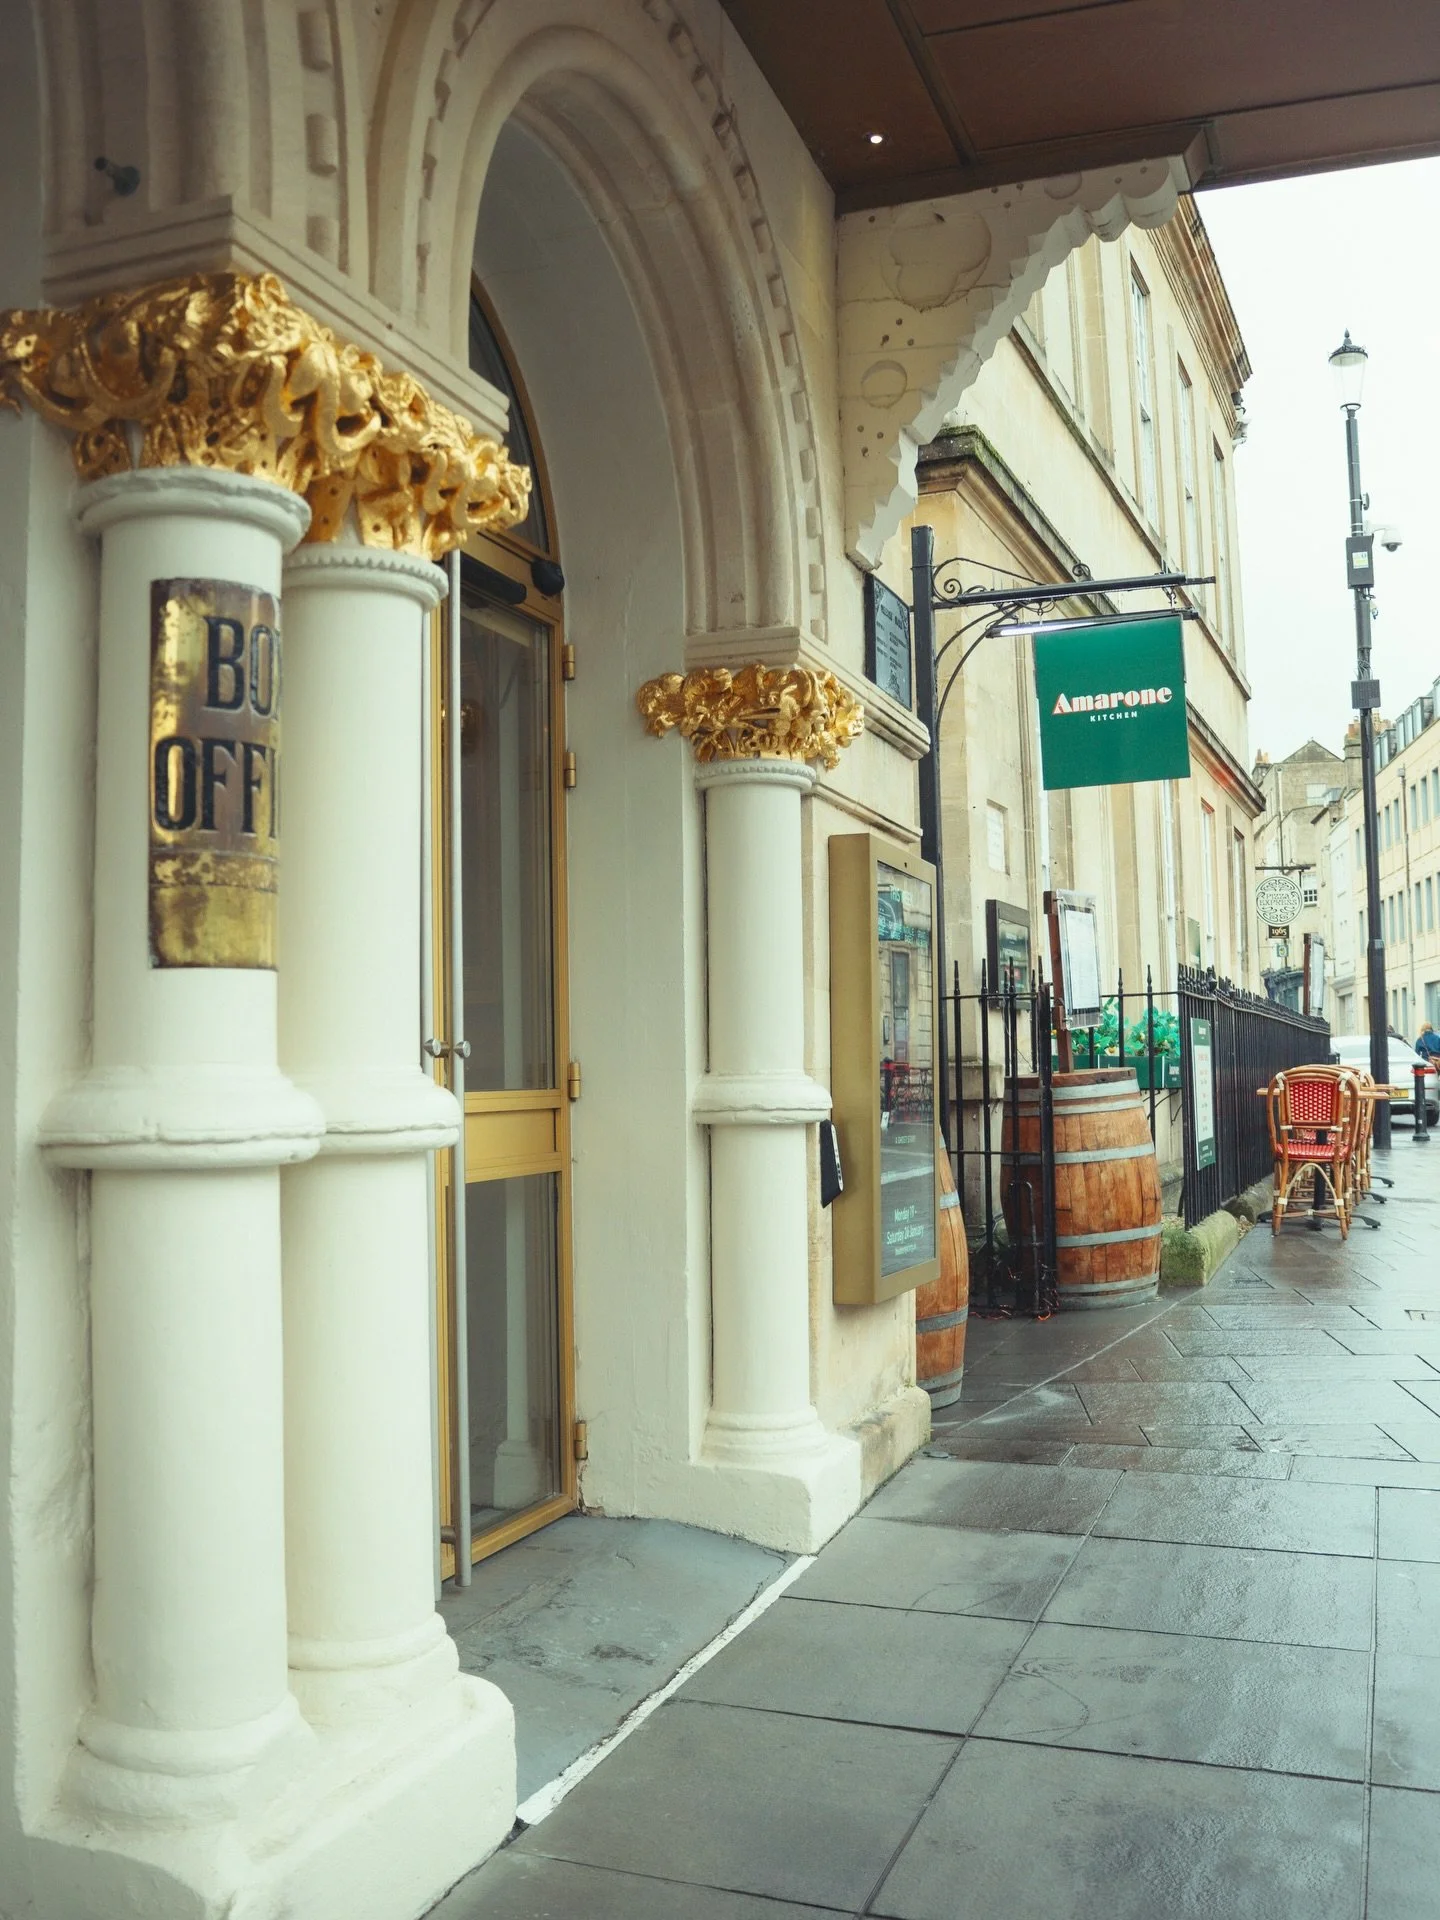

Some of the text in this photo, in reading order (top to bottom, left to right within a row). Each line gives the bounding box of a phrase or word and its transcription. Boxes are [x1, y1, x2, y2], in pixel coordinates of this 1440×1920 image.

[1053, 687, 1173, 714] Amarone
[1090, 711, 1138, 722] KITCHEN
[1271, 926, 1287, 936] 1965
[894, 1208, 909, 1223] Monday
[886, 1230, 904, 1245] Saturday
[909, 1225, 924, 1240] January
